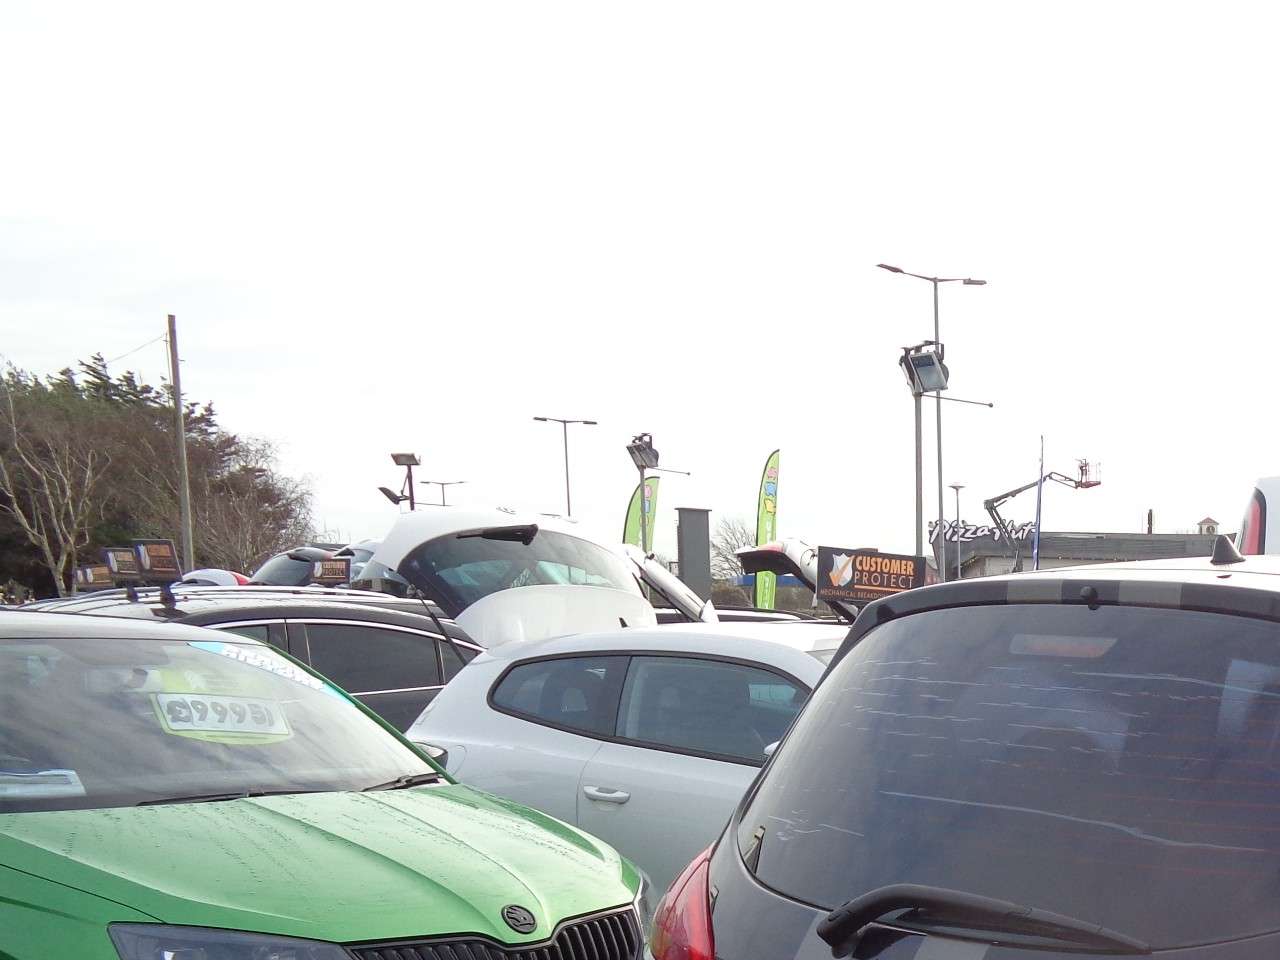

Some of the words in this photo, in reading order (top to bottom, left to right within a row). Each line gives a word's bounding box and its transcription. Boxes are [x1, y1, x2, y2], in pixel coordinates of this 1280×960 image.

[928, 519, 991, 544] Pizza
[856, 556, 914, 575] CUSTOMER
[854, 571, 915, 588] PROTECT
